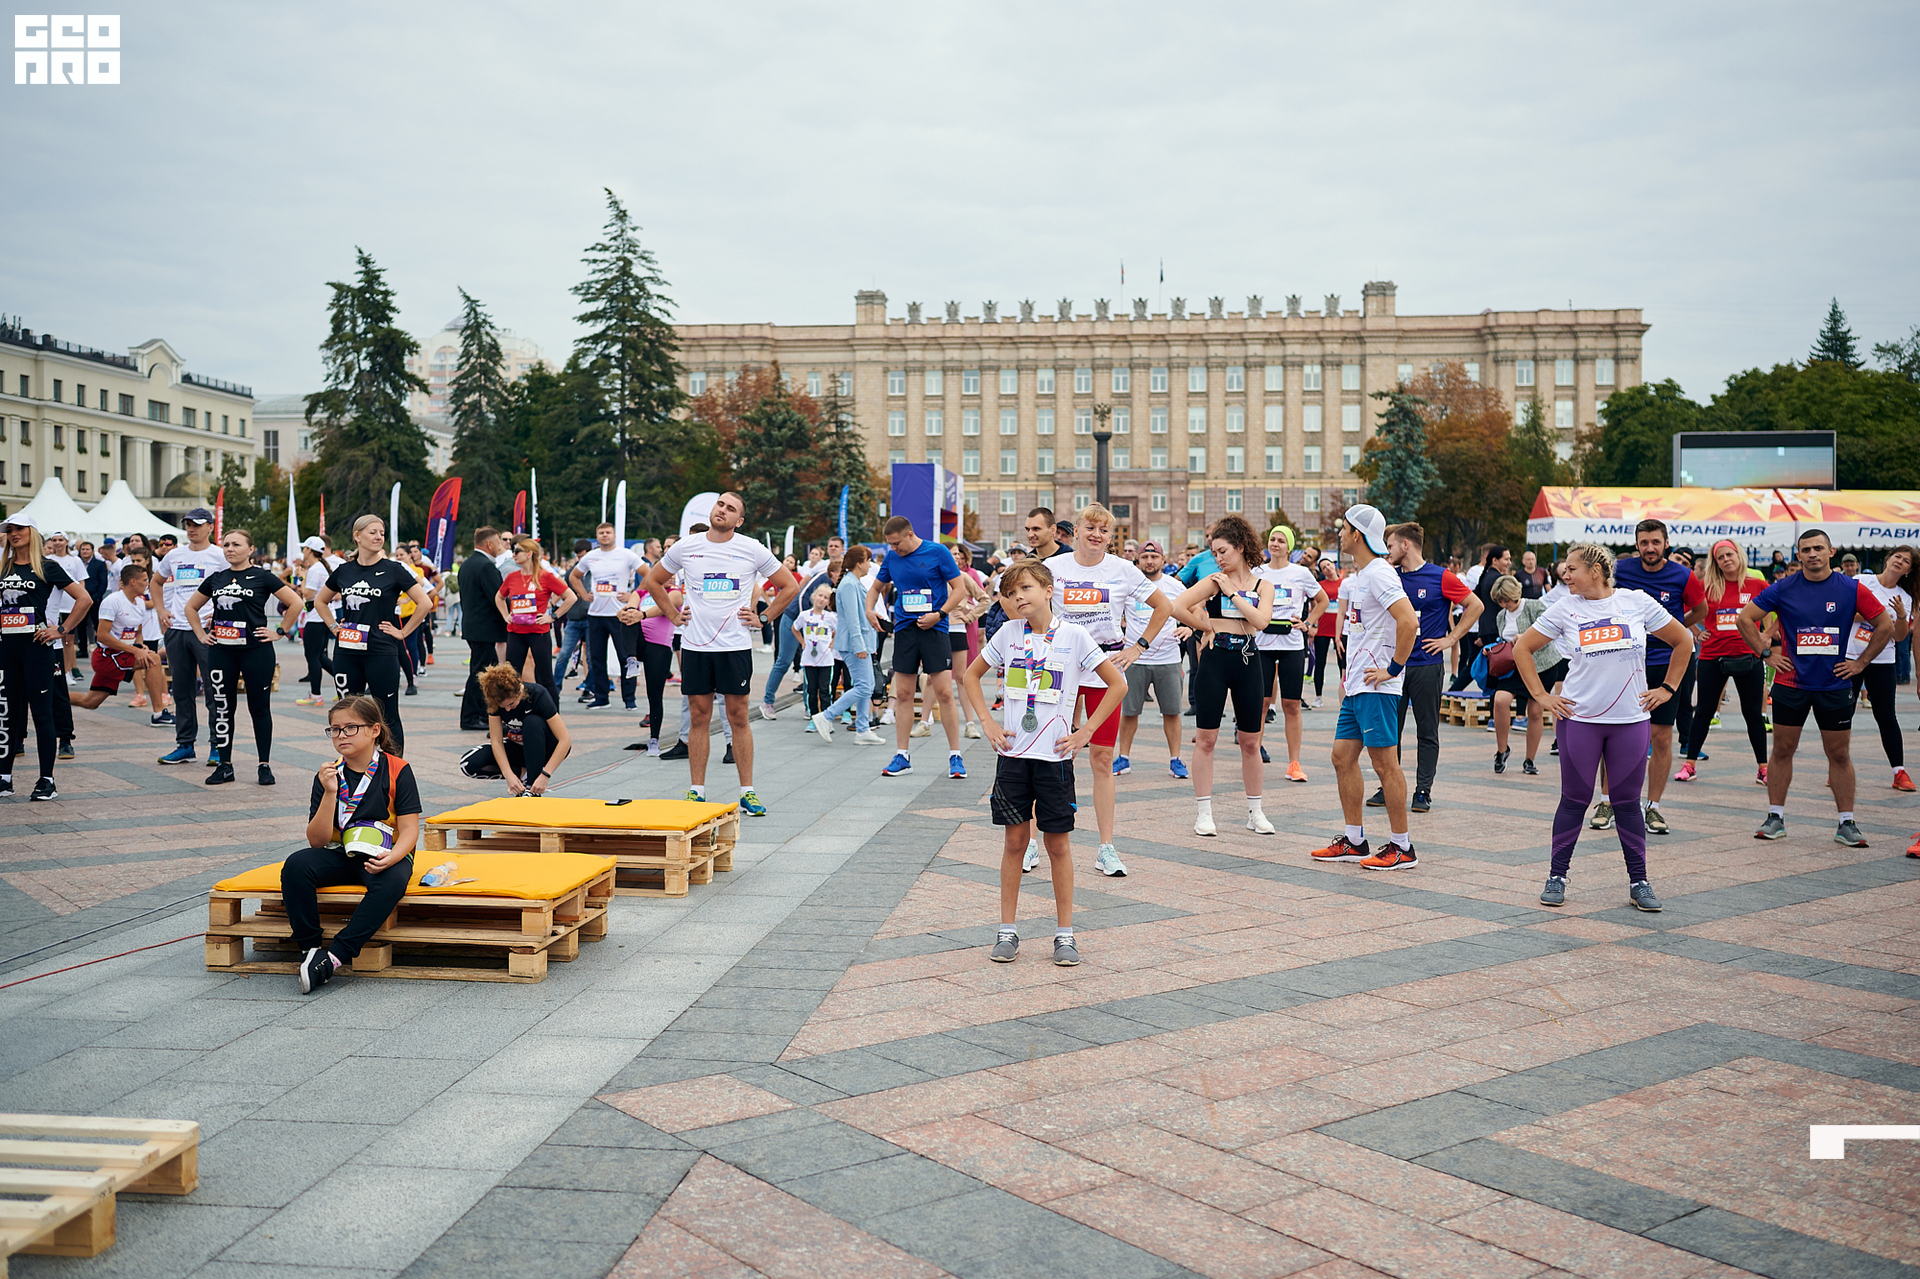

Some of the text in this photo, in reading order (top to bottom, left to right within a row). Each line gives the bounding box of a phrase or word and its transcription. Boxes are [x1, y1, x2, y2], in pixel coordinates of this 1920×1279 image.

[1584, 524, 1766, 536] КАМЕ ХРАНЕНИЯ
[179, 570, 197, 579] 1052
[707, 581, 729, 590] 1018
[905, 596, 922, 604] 1331
[1066, 590, 1099, 601] 5241
[513, 599, 530, 608] 5424
[2, 615, 26, 625] 5560
[216, 627, 238, 637] 5562
[340, 629, 361, 641] 5563
[1583, 627, 1619, 642] 5133
[1857, 630, 1871, 641] 54
[1799, 635, 1830, 645] 2034
